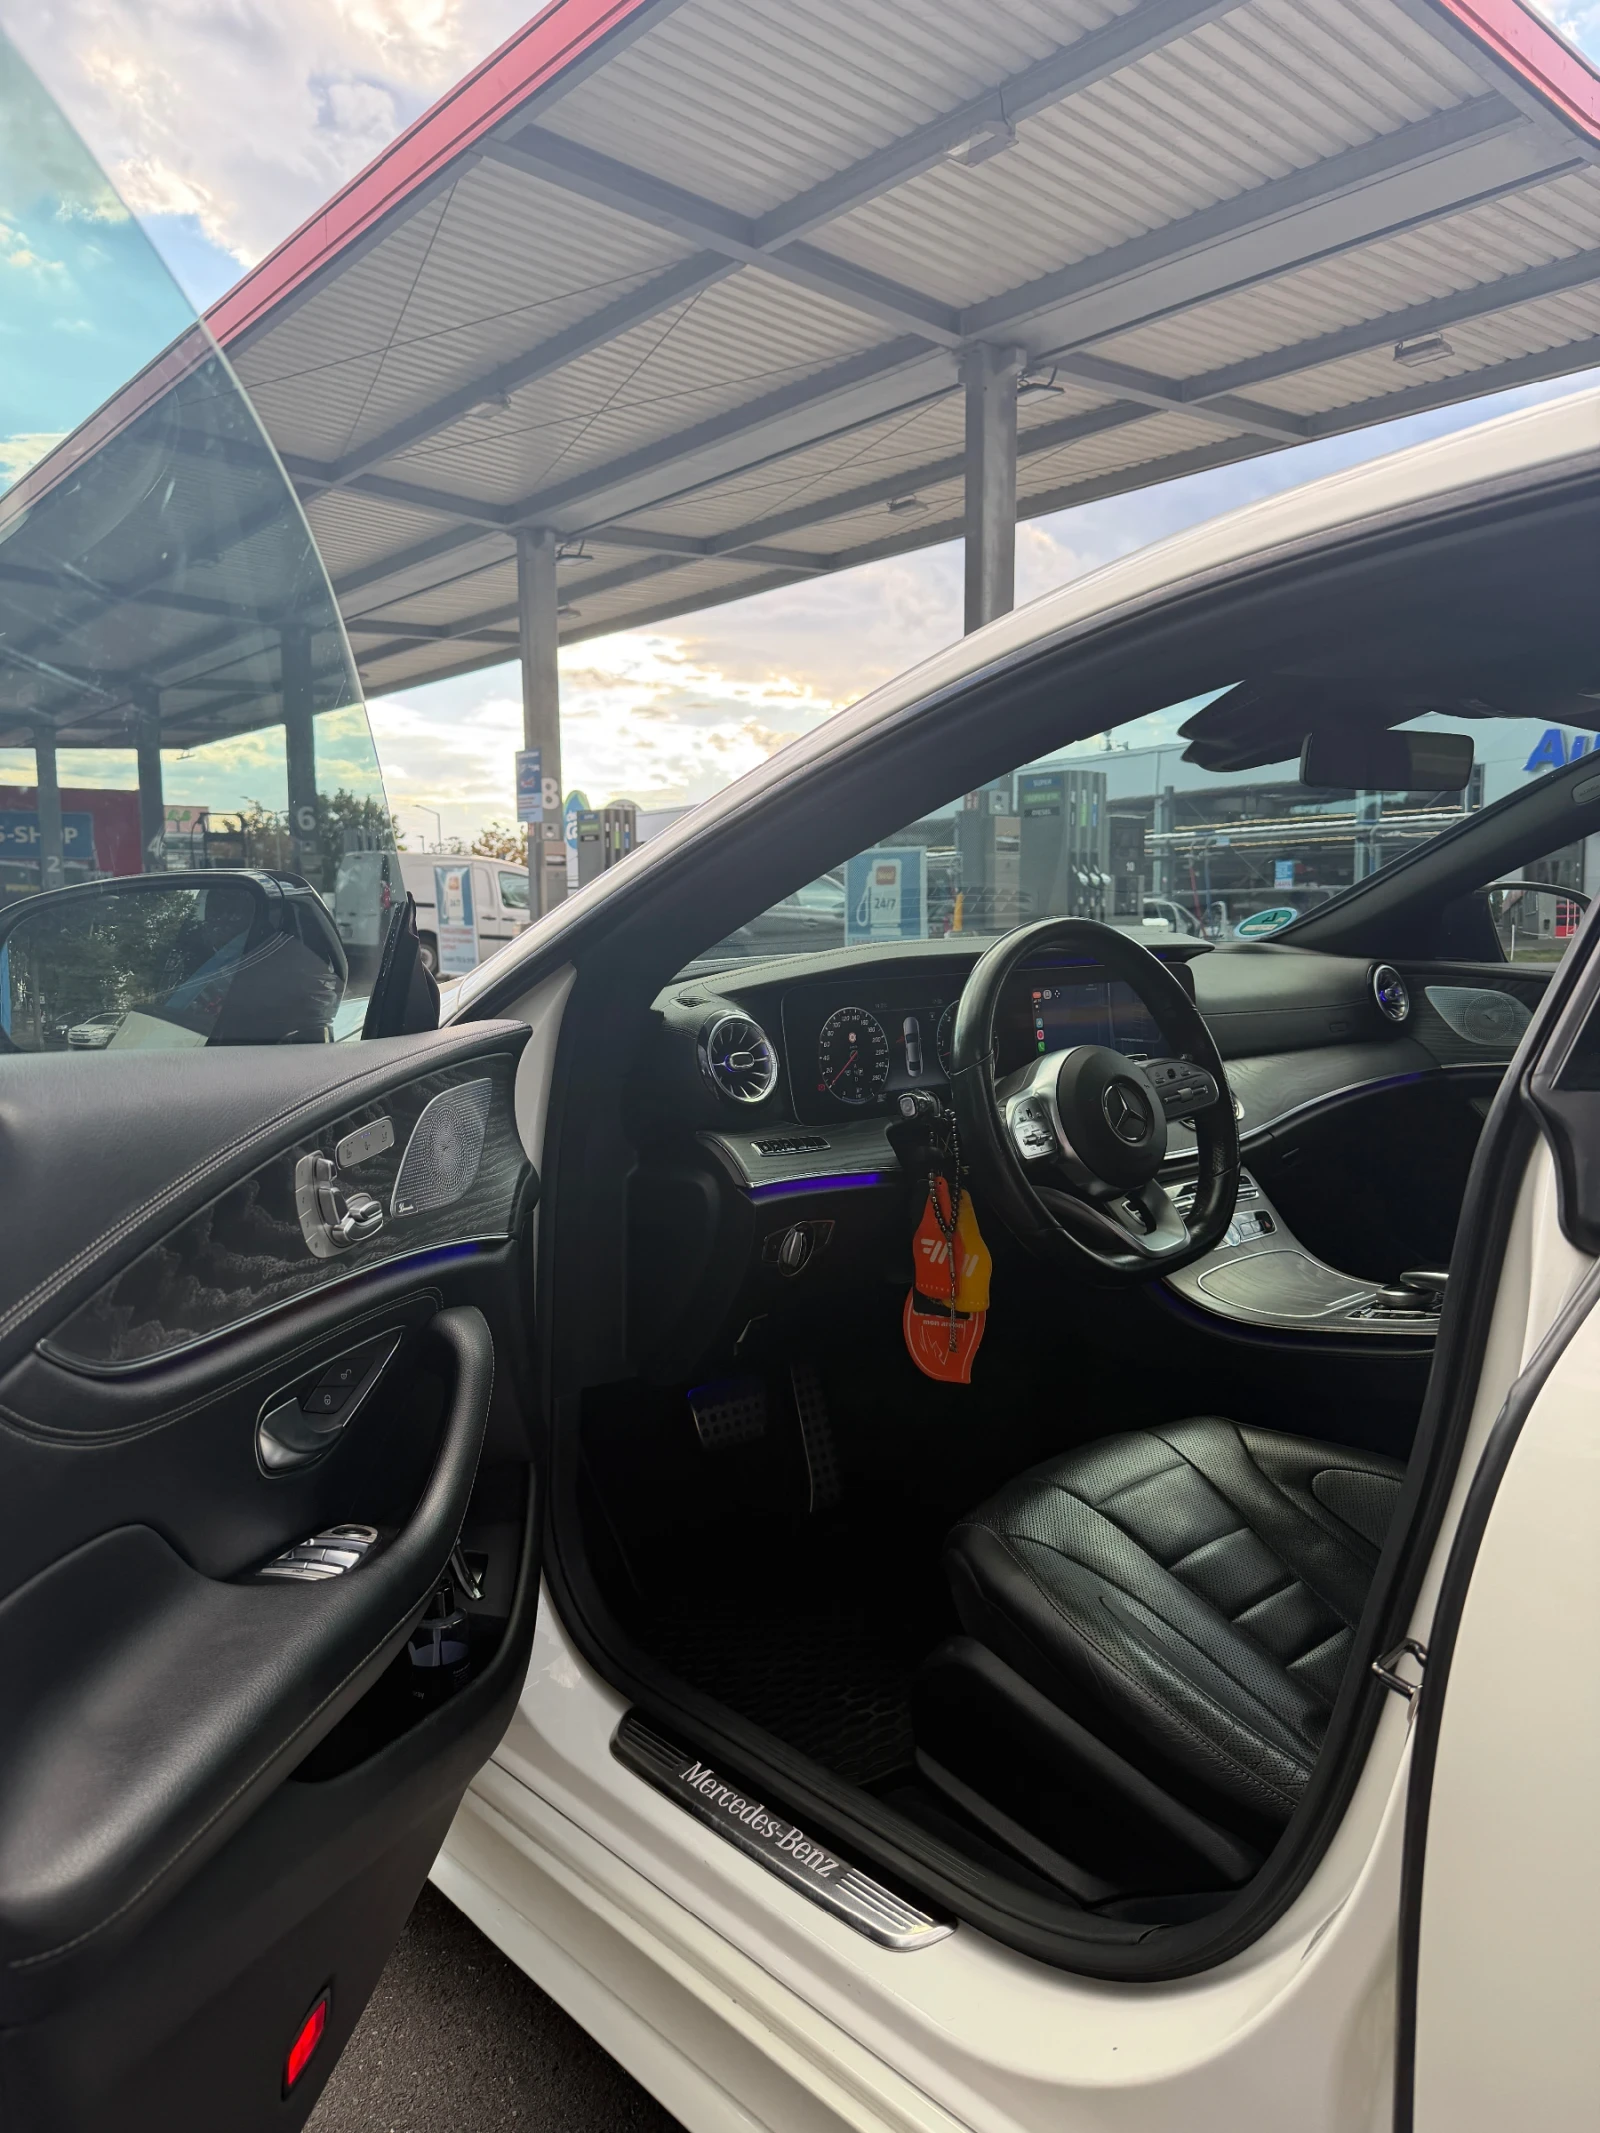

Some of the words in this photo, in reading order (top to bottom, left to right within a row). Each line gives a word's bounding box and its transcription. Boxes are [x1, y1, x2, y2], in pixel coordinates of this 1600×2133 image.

[541, 777, 560, 810] 8
[297, 806, 316, 831] 6
[0, 825, 78, 844] -SHP
[47, 856, 60, 873] 2
[874, 898, 896, 910] 24/7
[679, 1761, 839, 1878] Mercedes-Benz
